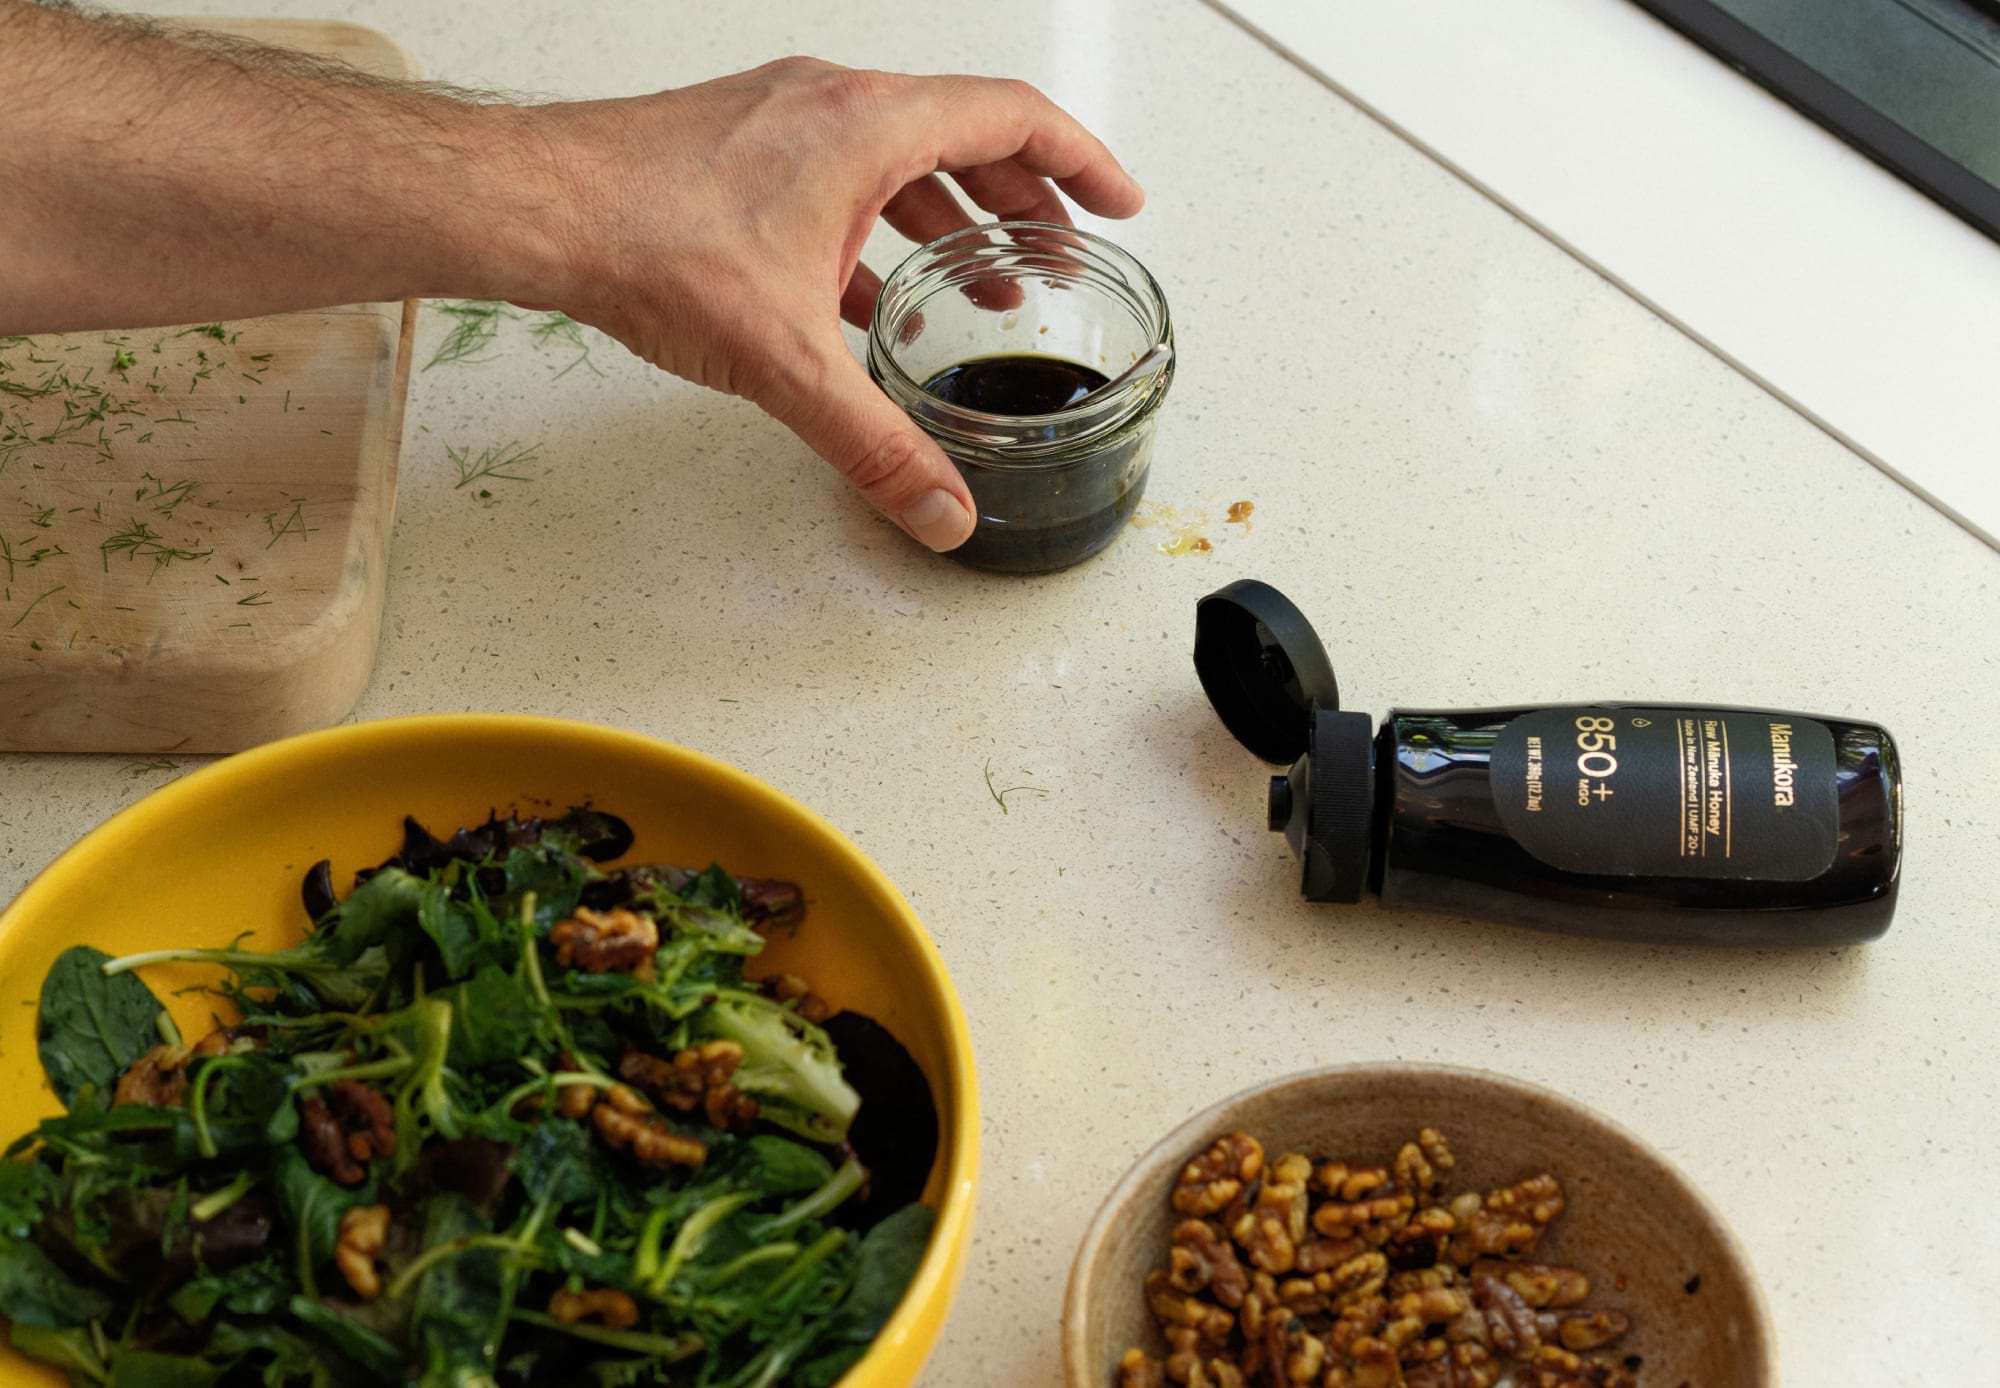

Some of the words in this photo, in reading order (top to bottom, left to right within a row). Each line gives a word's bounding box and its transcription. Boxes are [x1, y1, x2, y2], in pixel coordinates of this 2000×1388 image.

[1704, 720, 1718, 739] Raw
[1687, 745, 1697, 764] New
[1769, 723, 1799, 806] Manukora
[1578, 778, 1590, 806] MGO
[1687, 765, 1698, 802] Zealand
[1688, 809, 1699, 834] UMF
[1706, 790, 1723, 836] Honey
